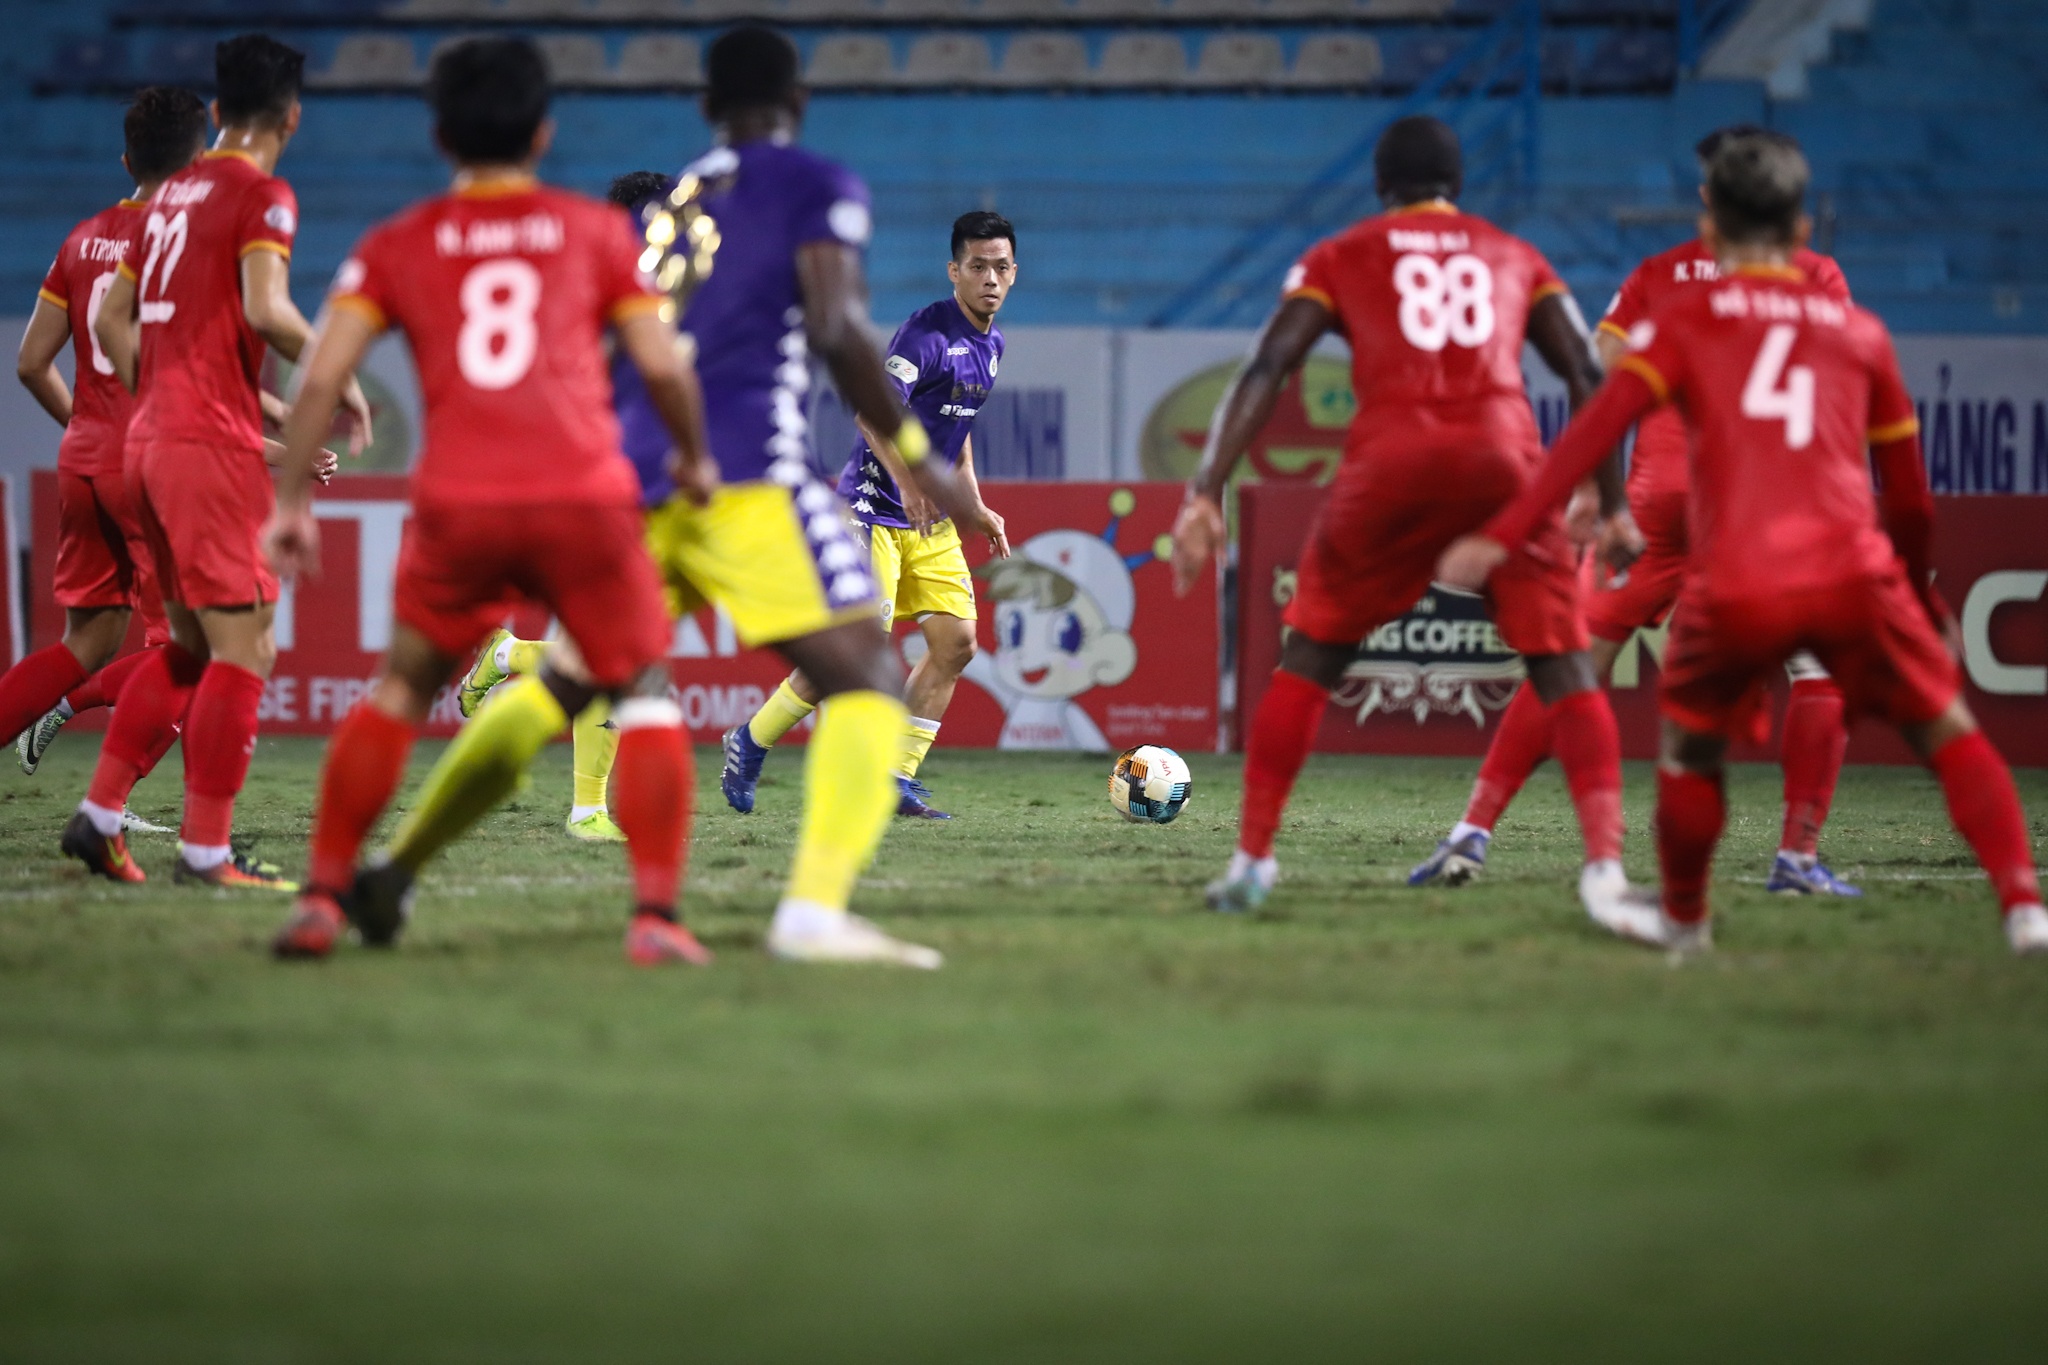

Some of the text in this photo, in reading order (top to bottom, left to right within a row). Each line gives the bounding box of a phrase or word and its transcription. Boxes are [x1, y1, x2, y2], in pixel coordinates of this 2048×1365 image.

[140, 210, 188, 323] 22
[1392, 253, 1494, 351] 88
[457, 258, 542, 391] 8
[1741, 324, 1815, 450] 4
[1404, 618, 1519, 654] COFFE
[1159, 757, 1172, 777] VPF
